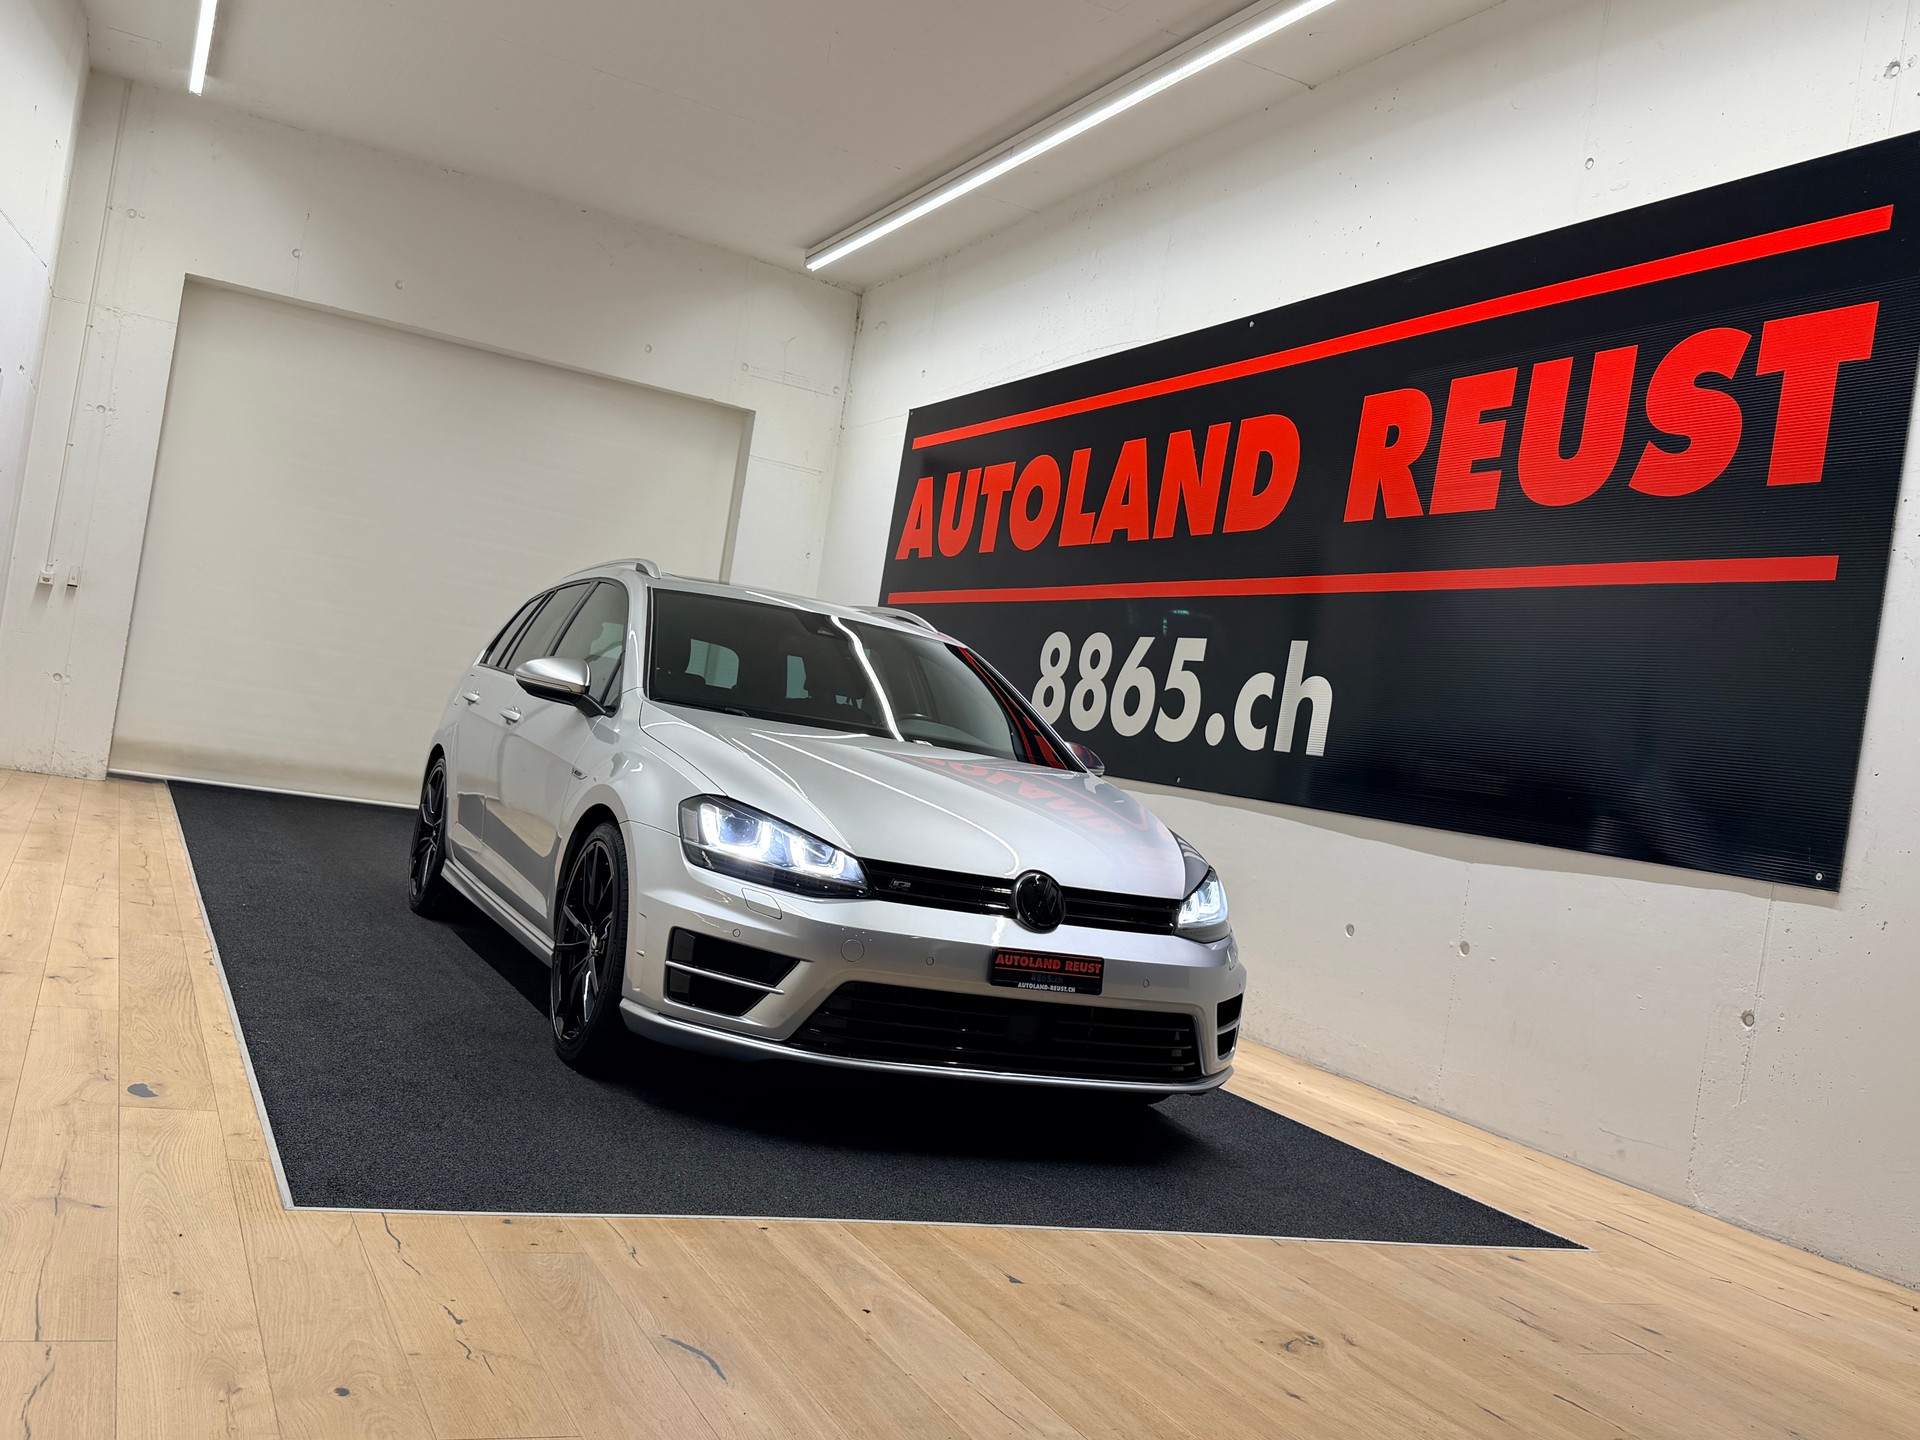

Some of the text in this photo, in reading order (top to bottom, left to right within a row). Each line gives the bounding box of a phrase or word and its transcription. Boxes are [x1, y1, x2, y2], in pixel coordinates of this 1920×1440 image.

[895, 300, 1880, 560] AUTOLAND REUST
[1031, 631, 1334, 757] 8865.ch
[995, 954, 1102, 974] AUTOLAND REUST
[1017, 982, 1076, 993] AUTOLAND-REUST.CH
